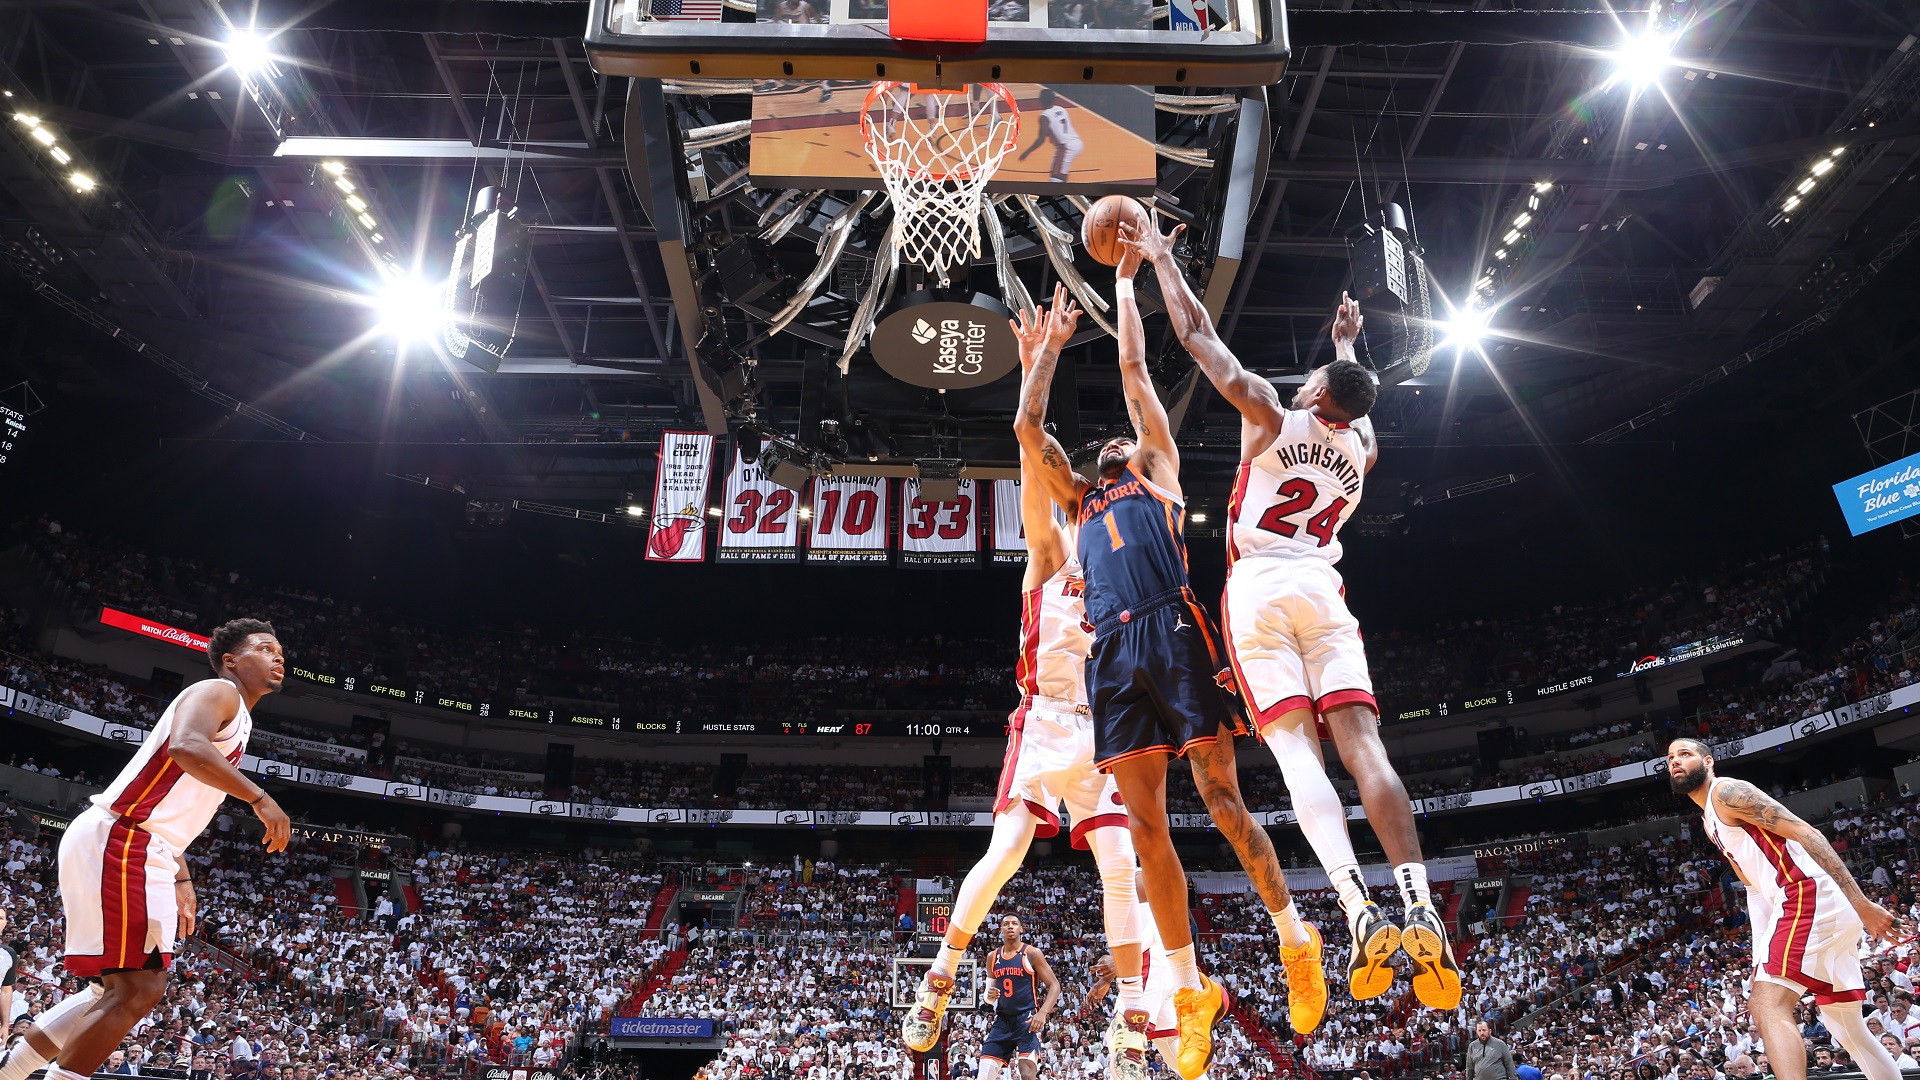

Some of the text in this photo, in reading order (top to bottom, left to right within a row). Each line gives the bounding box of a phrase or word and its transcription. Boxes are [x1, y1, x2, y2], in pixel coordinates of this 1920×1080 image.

[933, 320, 964, 374] Kaseya
[958, 320, 986, 374] Center
[0, 406, 24, 420] STATS
[5, 418, 26, 431] Knicks
[8, 428, 18, 438] 14
[2, 441, 12, 450] 18
[1276, 443, 1360, 496] HIGHSMITH
[1857, 466, 1920, 498] Florida
[1104, 481, 1145, 506] YORK
[1864, 492, 1900, 512] Blue
[728, 490, 794, 534] 32
[818, 490, 878, 535] 10
[907, 494, 972, 539] 33
[1256, 477, 1350, 548] 24
[1102, 510, 1126, 552] 1
[141, 624, 208, 648] WATCH Bally SPOR
[1668, 648, 1704, 662] Technology
[1712, 638, 1744, 650] Solutions
[1630, 656, 1665, 673] Acordis
[293, 668, 336, 684] TOTAL REB
[370, 685, 406, 697] OFF REB
[1537, 676, 1592, 696] HUSTLE STATS
[14, 691, 73, 721] DEFENSE
[438, 698, 472, 710] DEF REB
[1464, 697, 1496, 708] BLOCKS
[1834, 692, 1892, 726] DEFENSE
[509, 710, 538, 718] STEALS
[572, 716, 603, 725] ASSISTS
[1399, 709, 1430, 720] ASSISTS
[816, 724, 844, 733] HEAT
[855, 724, 872, 735] 87
[906, 724, 940, 735] 11:00
[963, 726, 970, 734] 4
[300, 766, 354, 788] DEFENSE
[1563, 769, 1612, 793] DEFENSE
[429, 787, 478, 806] DEFENSE
[1424, 794, 1472, 812] DEFENSE
[572, 803, 619, 819] DEFENSE
[688, 809, 733, 823] DEFENSE
[816, 811, 861, 824] DEFENSE
[930, 812, 975, 826] DEFENSE
[1474, 841, 1539, 858] BACARDÍ
[361, 870, 390, 880] BACARDÍ
[1475, 879, 1502, 889] BACARDÍ
[926, 906, 950, 916] 11:00
[932, 916, 947, 934] 10
[994, 967, 1024, 978] NEW YORK
[1003, 978, 1013, 998] 9
[621, 1021, 701, 1034] ticketmaster
[486, 1069, 510, 1080] Bally
